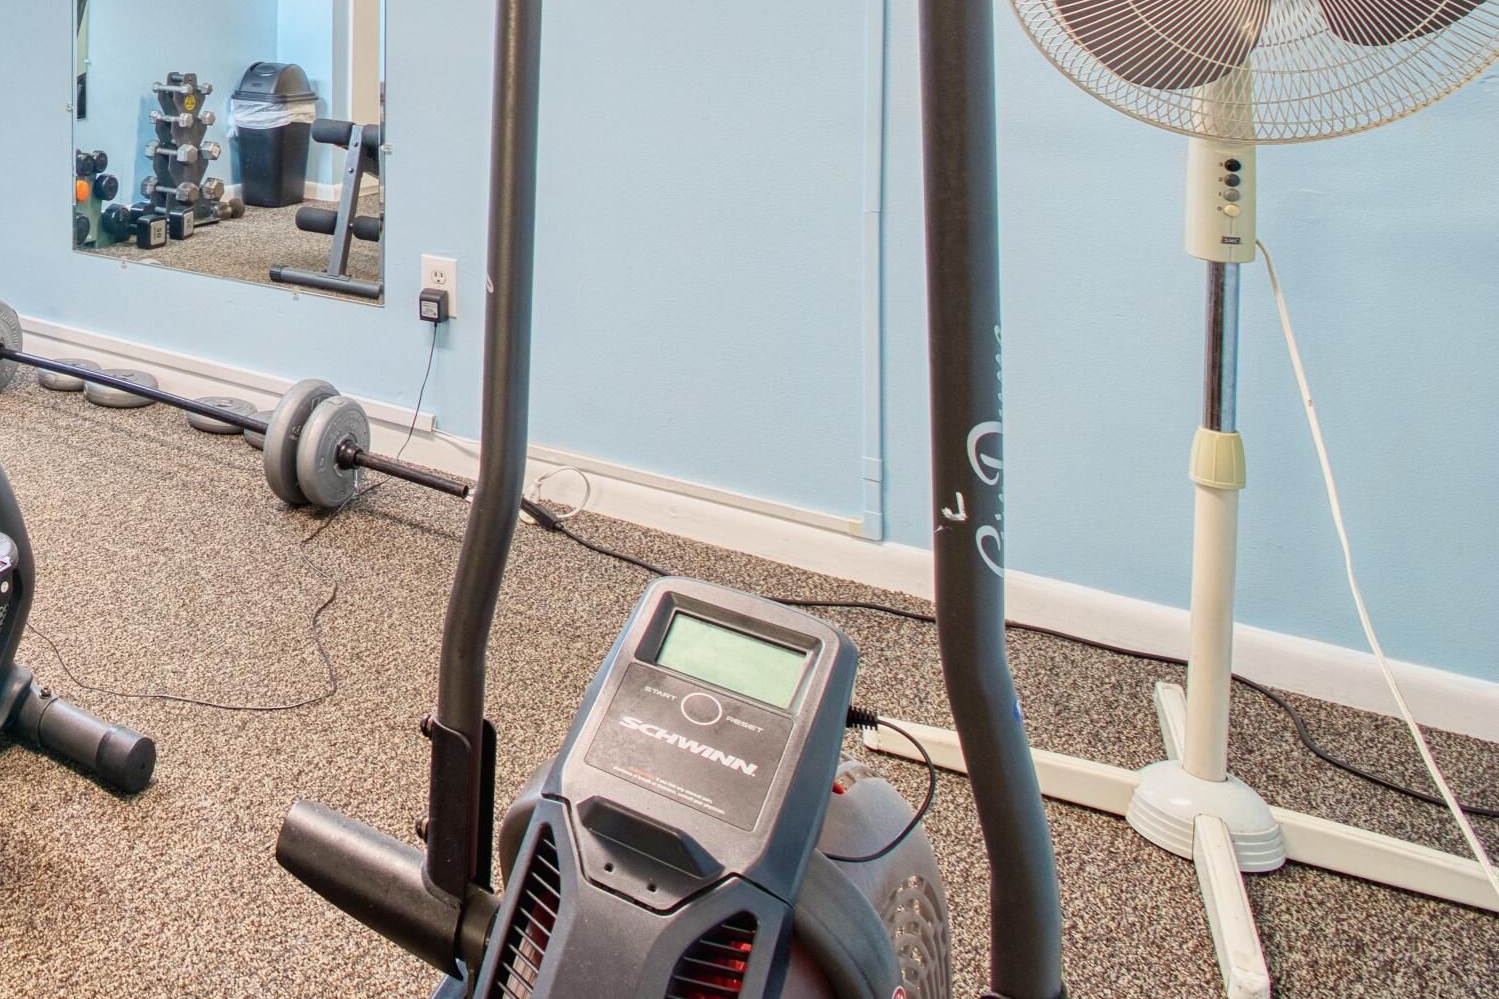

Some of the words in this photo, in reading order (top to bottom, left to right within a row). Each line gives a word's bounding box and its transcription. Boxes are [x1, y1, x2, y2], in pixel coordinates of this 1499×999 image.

[644, 685, 677, 701] START
[725, 715, 764, 734] RESET
[619, 716, 758, 777] SCHWINN
